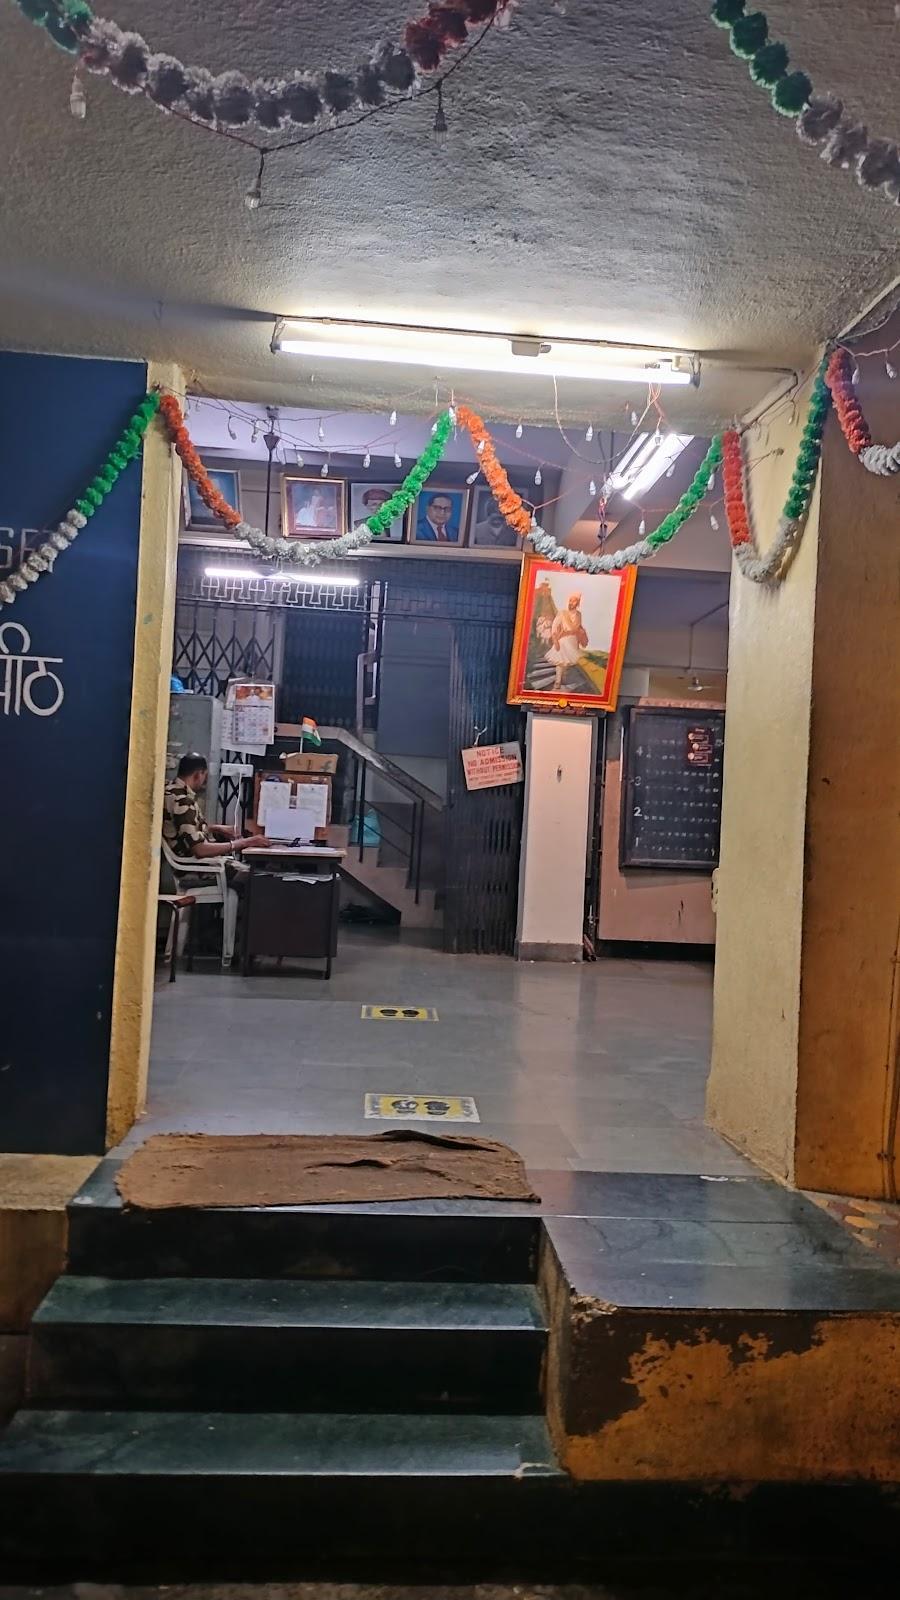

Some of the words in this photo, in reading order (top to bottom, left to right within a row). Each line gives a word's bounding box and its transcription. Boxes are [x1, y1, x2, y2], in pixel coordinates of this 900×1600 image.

[477, 746, 504, 757] NOTICE
[479, 754, 517, 766] ADMISSION
[467, 765, 491, 776] WITHOUT
[492, 761, 521, 772] PERMISSION
[633, 806, 642, 817] 2
